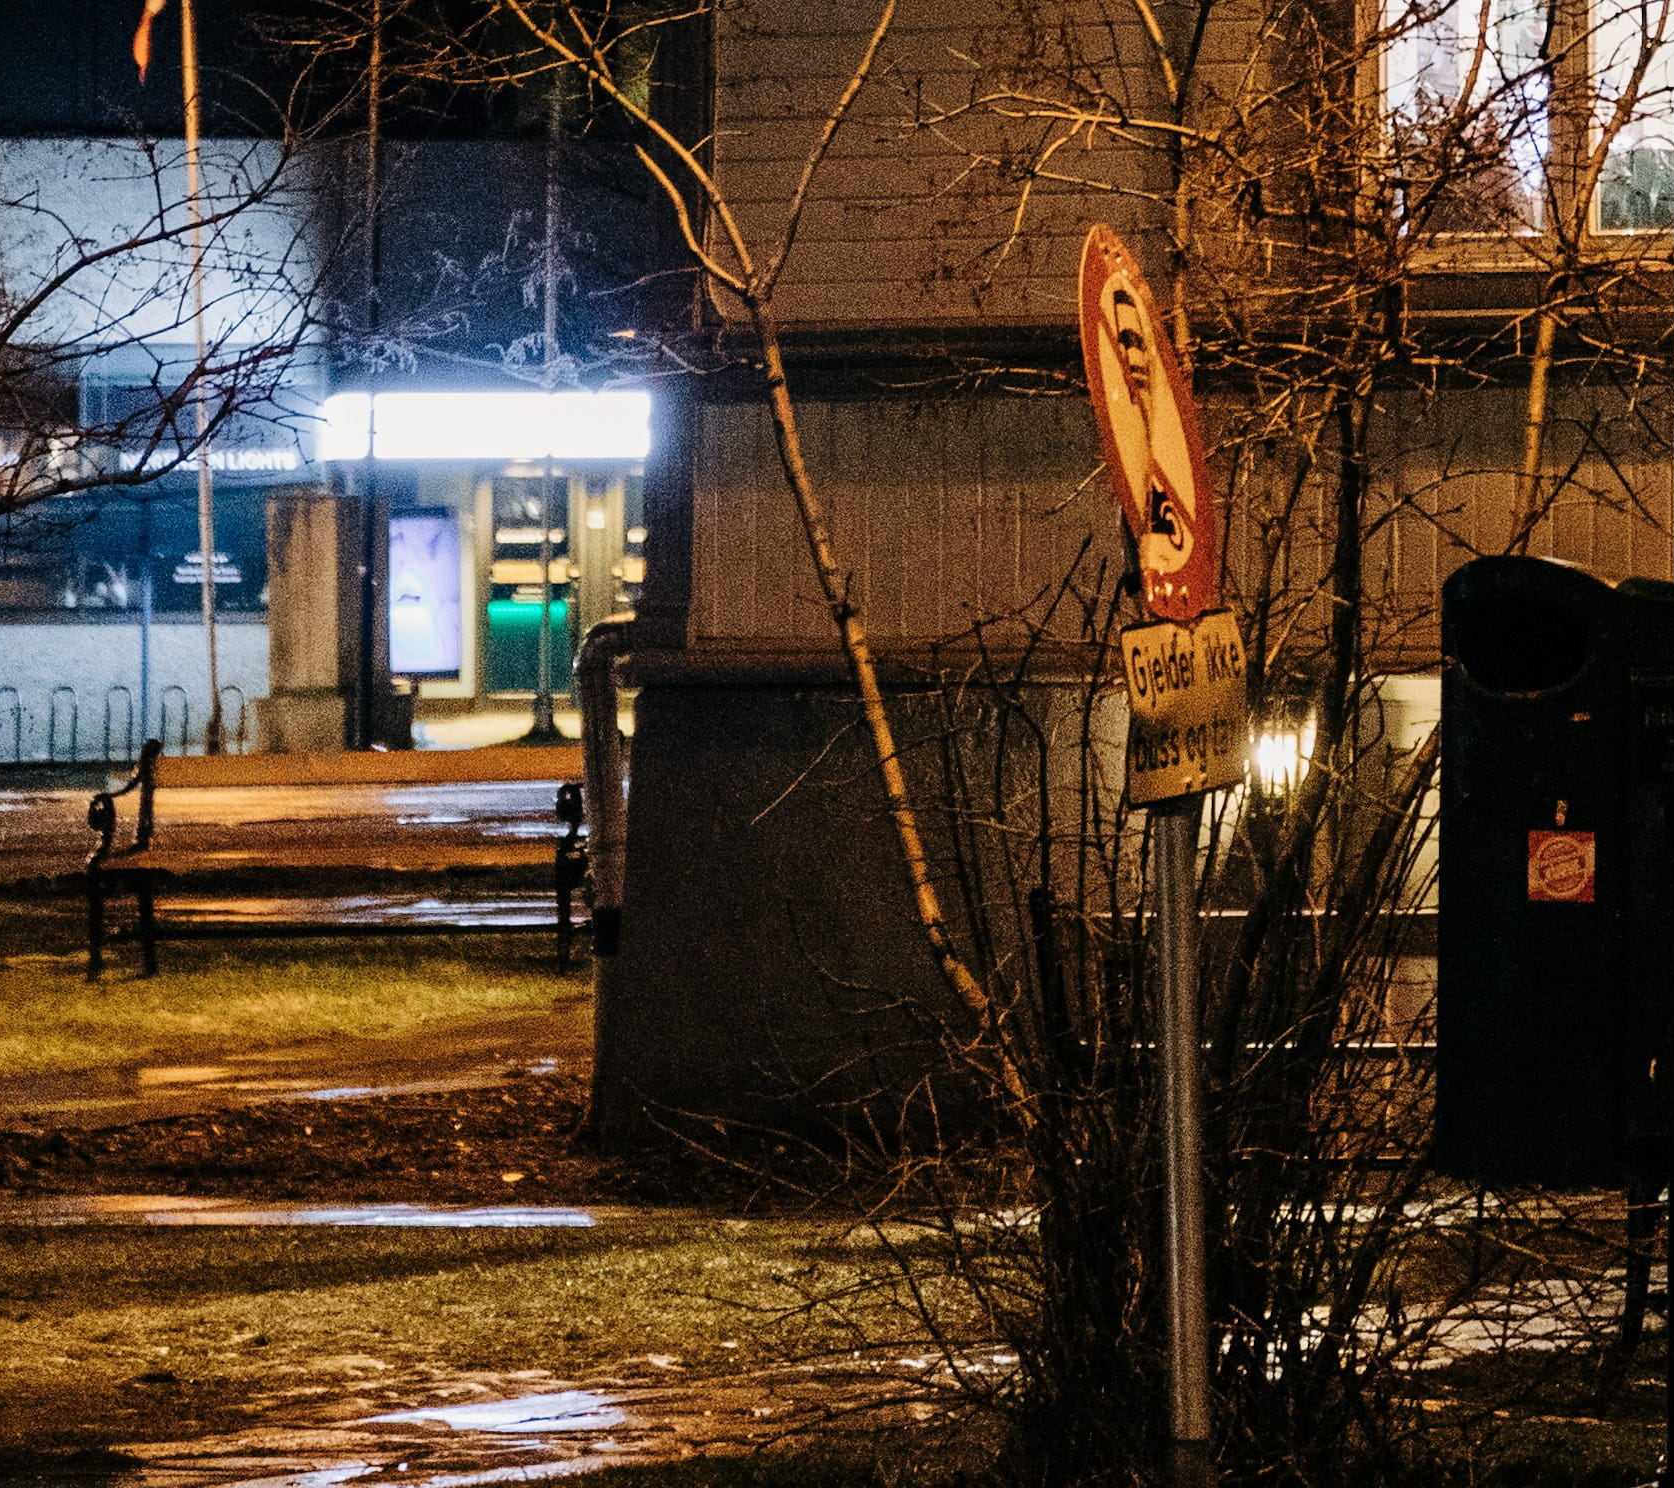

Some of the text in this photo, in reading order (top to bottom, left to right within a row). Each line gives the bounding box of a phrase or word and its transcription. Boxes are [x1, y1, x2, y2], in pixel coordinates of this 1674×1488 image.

[1132, 630, 1243, 708] Gjelder ikke
[1186, 722, 1207, 773] og
